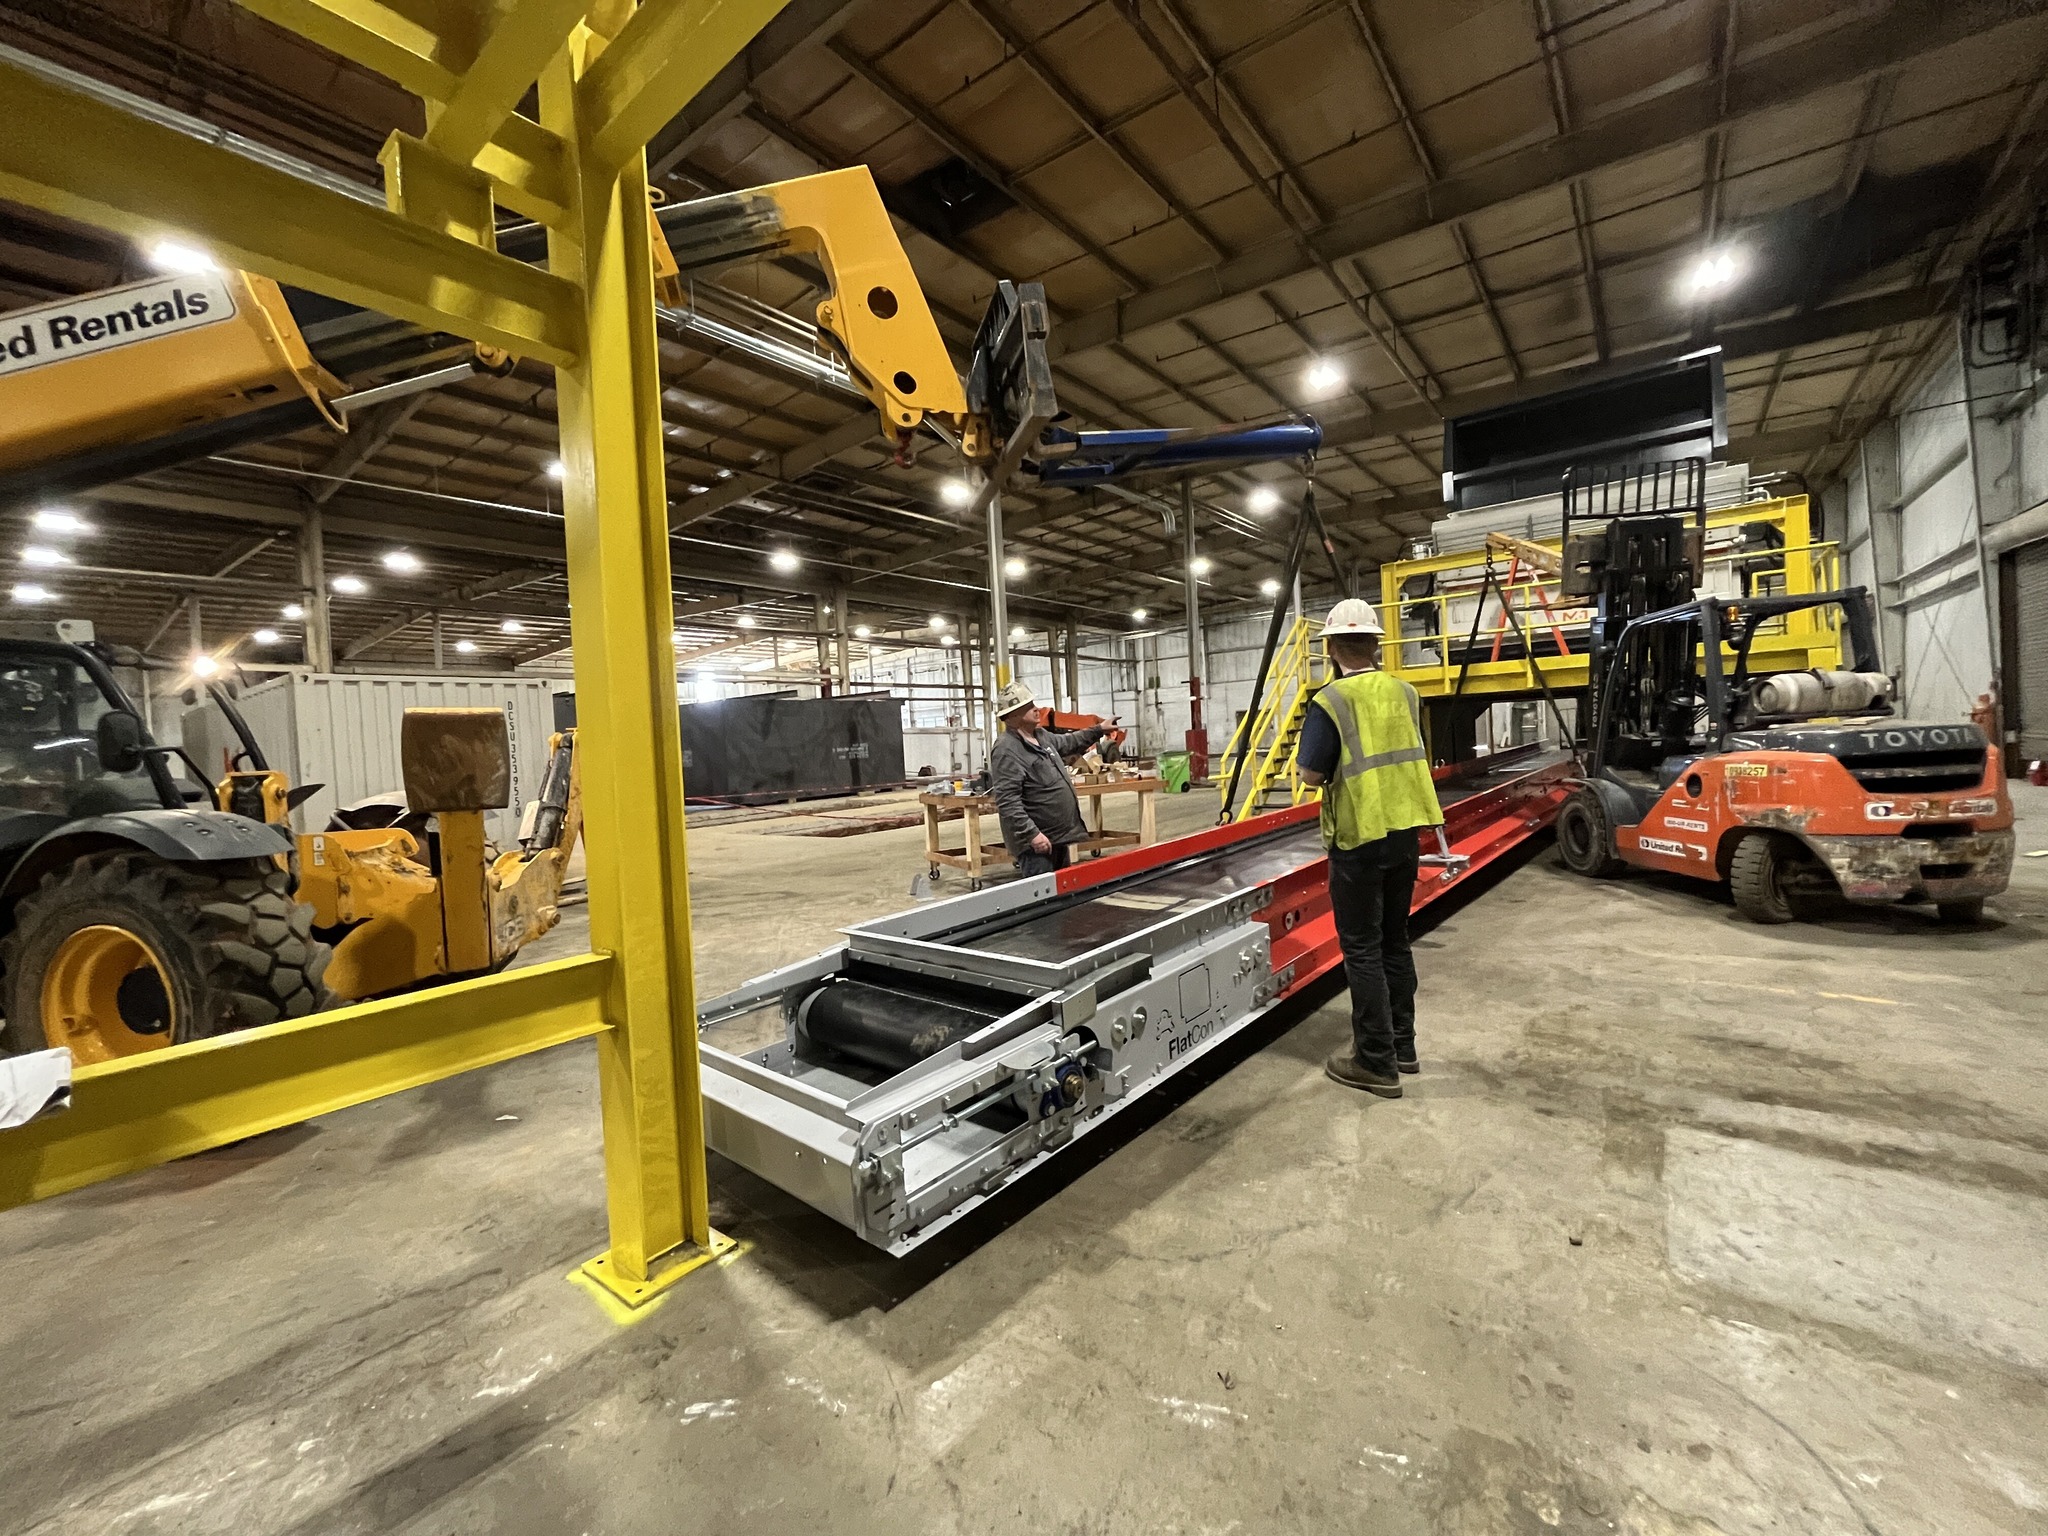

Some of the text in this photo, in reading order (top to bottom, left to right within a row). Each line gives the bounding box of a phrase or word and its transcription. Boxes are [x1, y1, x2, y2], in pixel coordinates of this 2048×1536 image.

[48, 288, 210, 350] Rentals
[1860, 728, 1977, 749] TOYOTA
[1168, 1020, 1214, 1060] FlatCon
